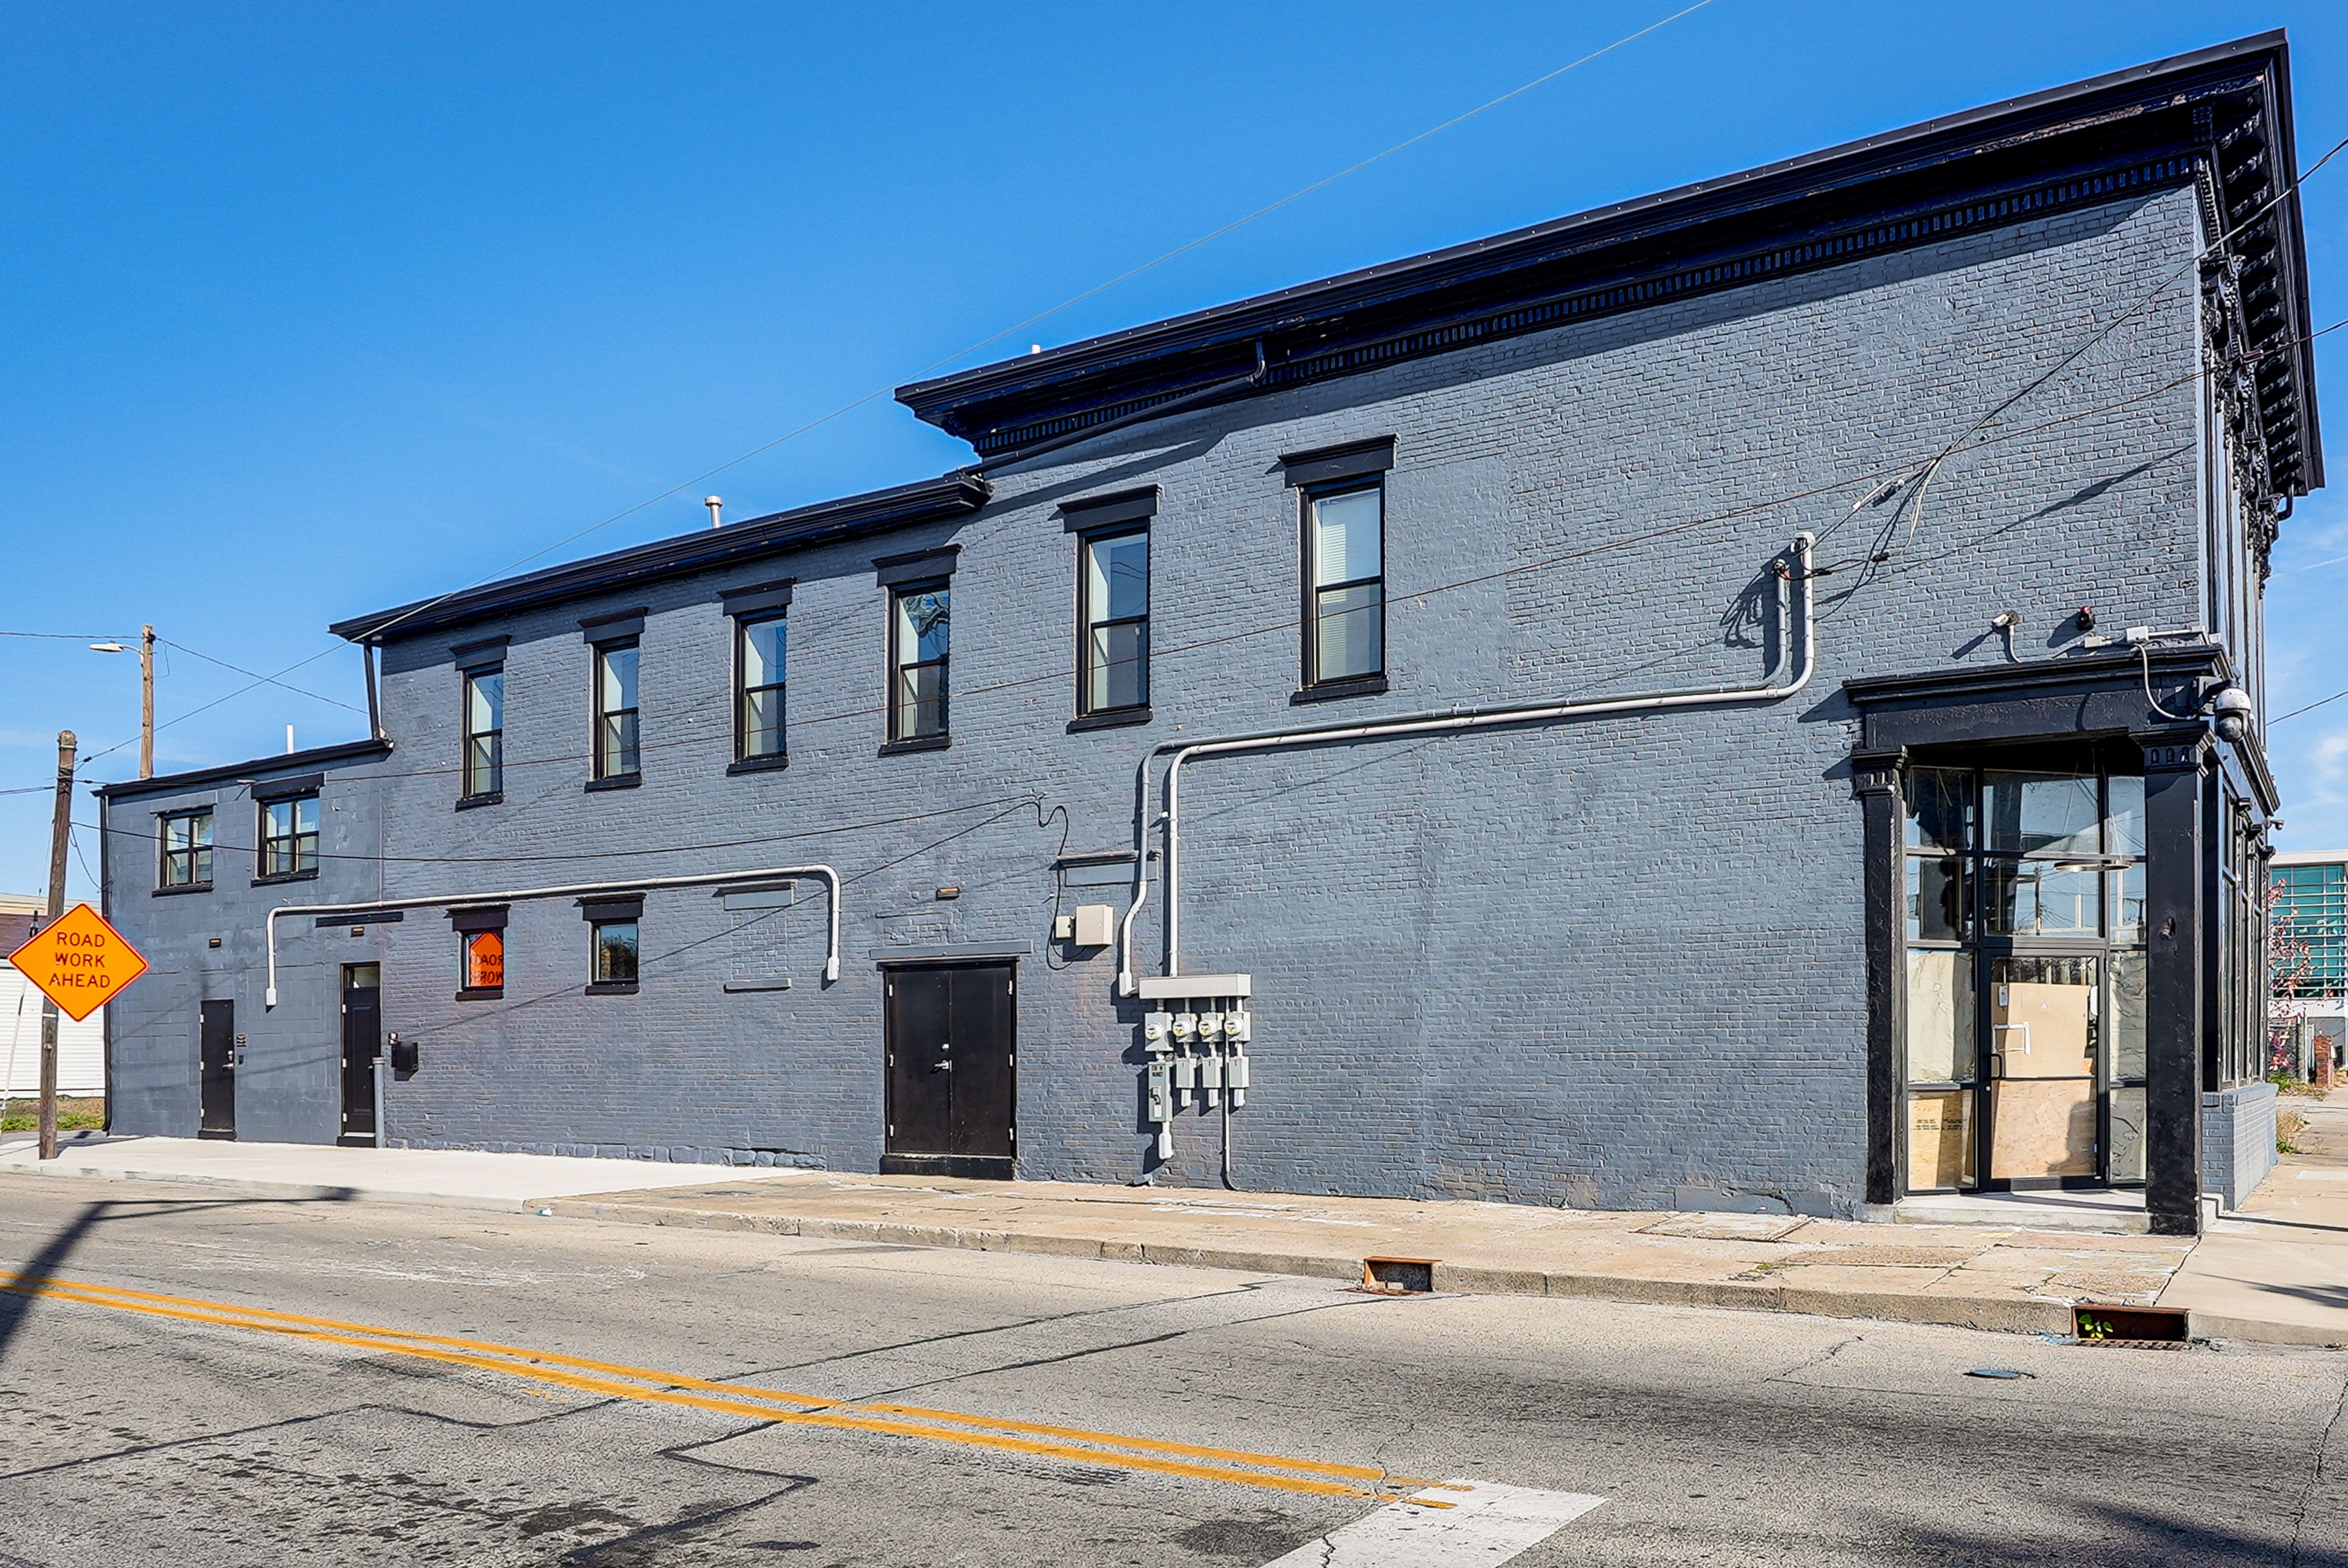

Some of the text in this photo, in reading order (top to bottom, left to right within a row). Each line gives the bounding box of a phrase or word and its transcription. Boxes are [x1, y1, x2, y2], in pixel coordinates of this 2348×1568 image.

[57, 932, 105, 948] ROAD
[55, 952, 105, 968] WORK
[48, 973, 110, 988] AHEAD
